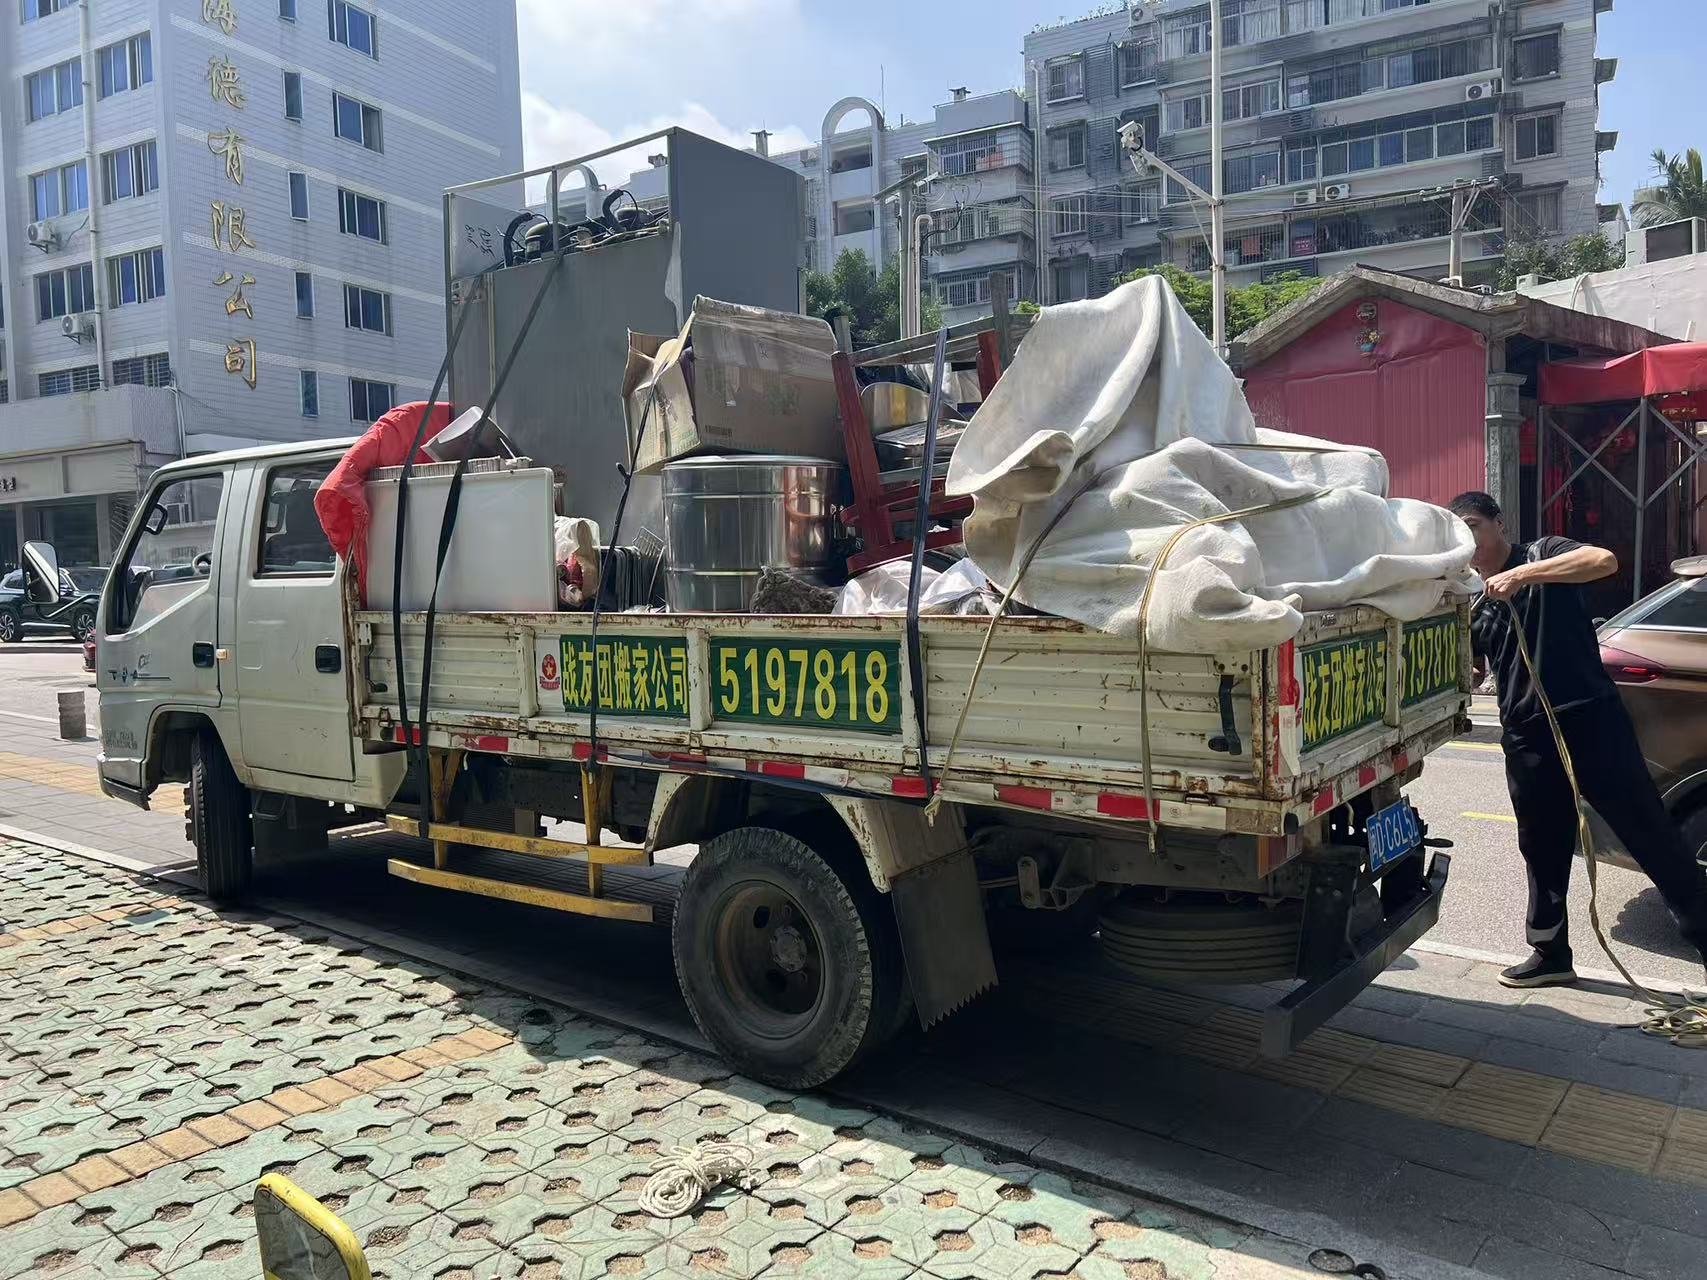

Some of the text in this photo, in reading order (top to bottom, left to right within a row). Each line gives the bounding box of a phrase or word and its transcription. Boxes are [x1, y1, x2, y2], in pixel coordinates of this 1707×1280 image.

[562, 641, 890, 724] 战友团搬家公司 5197818
